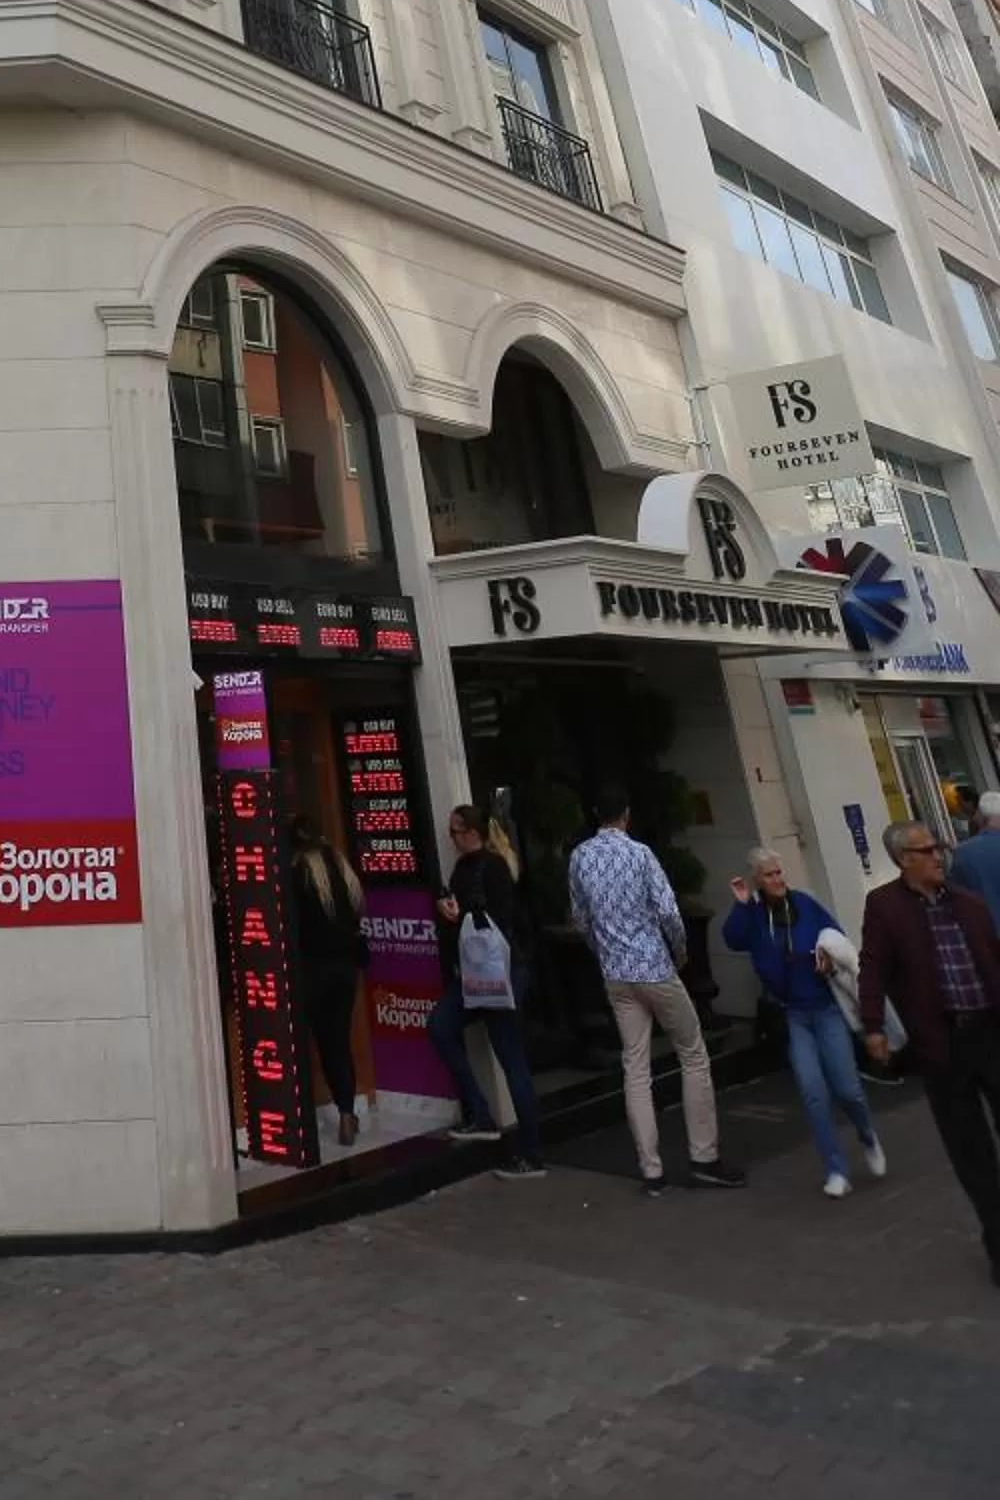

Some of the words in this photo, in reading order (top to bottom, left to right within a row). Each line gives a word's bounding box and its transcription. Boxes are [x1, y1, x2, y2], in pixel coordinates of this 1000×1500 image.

[749, 431, 860, 459] FOURSEVEN
[777, 451, 839, 470] HOTEL
[596, 580, 763, 628] FOURSEVEN
[764, 600, 840, 636] HOTEL
[0, 842, 116, 870] Золотая
[231, 781, 288, 1156] CHANGE
[388, 993, 437, 1011] Золота
